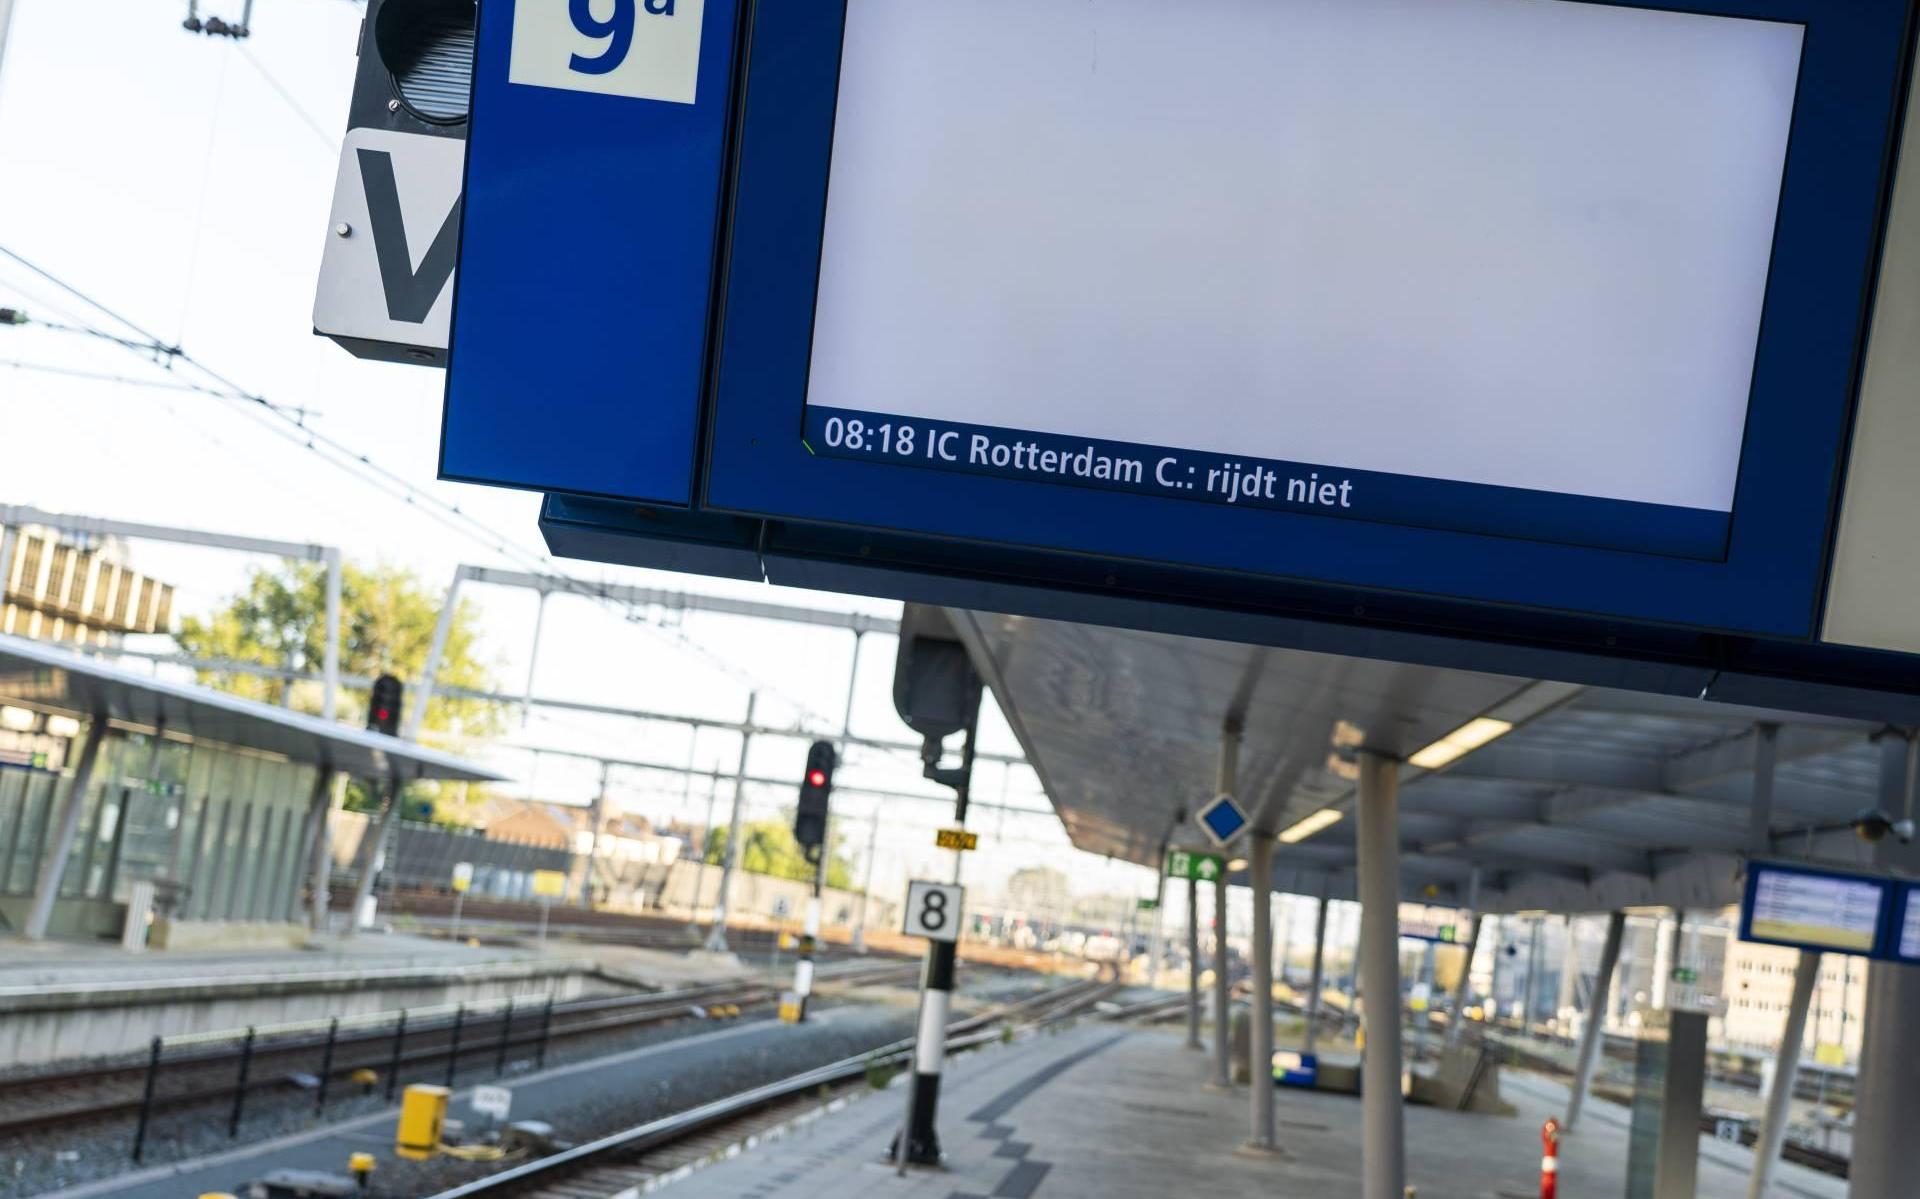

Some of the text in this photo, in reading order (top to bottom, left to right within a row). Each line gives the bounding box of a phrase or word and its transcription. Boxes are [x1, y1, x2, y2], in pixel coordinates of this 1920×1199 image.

[824, 417, 1353, 508] 08:18 IC Rotterdam C.: rijdt niet
[920, 889, 946, 931] 8
